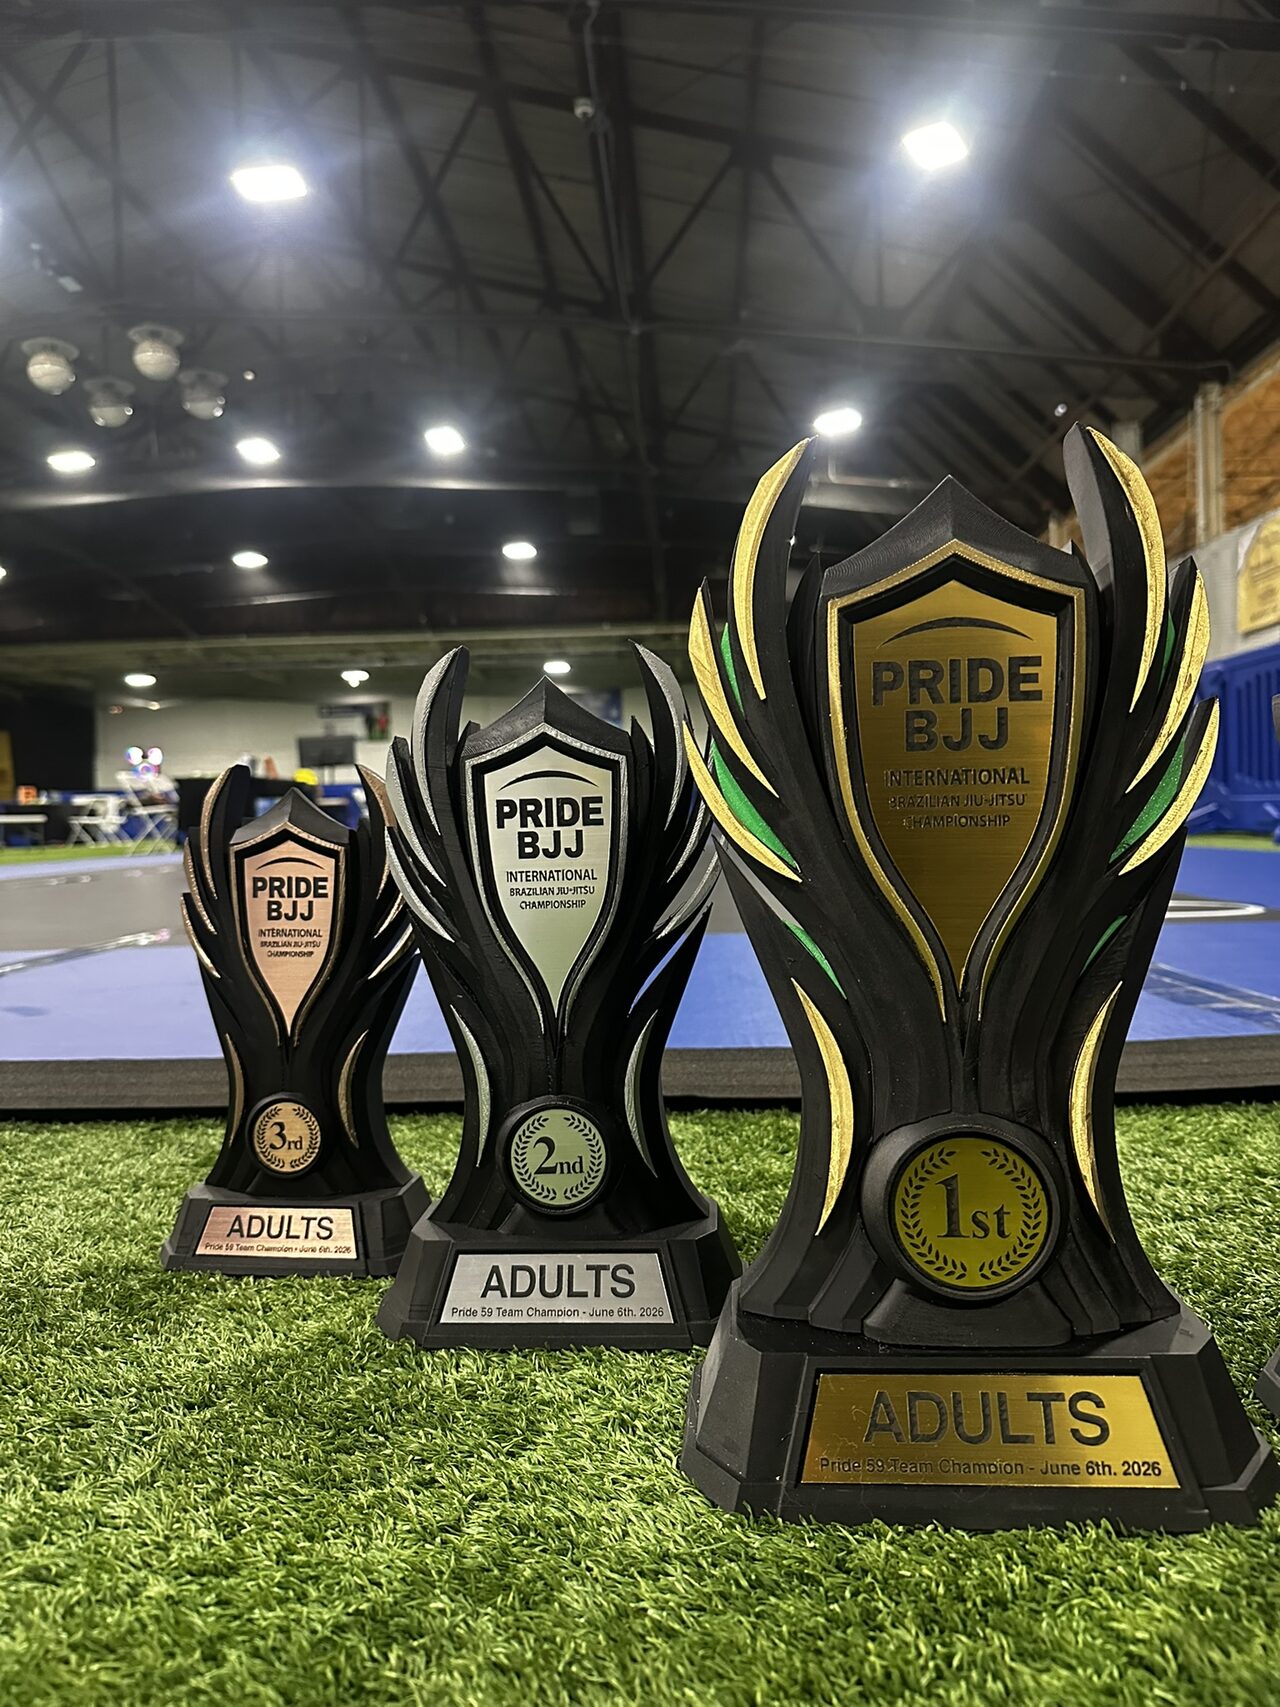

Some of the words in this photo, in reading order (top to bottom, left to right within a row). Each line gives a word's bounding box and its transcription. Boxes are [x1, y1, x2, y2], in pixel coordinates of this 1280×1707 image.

[872, 655, 1044, 706] PRIDE
[904, 707, 1009, 752] BJJ
[884, 767, 1030, 787] INTERNATIONAL
[889, 795, 960, 809] BRAZILIAN
[963, 793, 1026, 807] JIU-JITSU
[495, 795, 604, 829] PRIDE
[904, 814, 1011, 829] CHAMPIONSHIP
[517, 829, 584, 860] BJJ
[506, 868, 598, 883] INTERNATIONAL
[252, 876, 329, 898] PRIDE
[509, 886, 555, 897] BRAZILIAN
[556, 885, 595, 895] JIU-JITSU
[267, 900, 314, 921] BJJ
[519, 899, 587, 910] CHAMPIONSHIP
[258, 928, 323, 938] INTERNATIONAL
[266, 950, 315, 958] CHAMPIONSHIP
[269, 1121, 303, 1151] 3rd
[532, 1135, 585, 1175] 2nd
[935, 1173, 1012, 1239] 1st
[226, 1214, 334, 1240] ADULTS
[204, 1242, 223, 1251] Pride
[236, 1243, 254, 1252] Team
[256, 1244, 294, 1253] Champion
[334, 1245, 352, 1254] 2026
[480, 1263, 636, 1299] ADULTS
[451, 1306, 478, 1317] Pride
[480, 1306, 493, 1317] 59
[496, 1306, 523, 1317] Team
[526, 1306, 580, 1318] Champion
[588, 1306, 614, 1317] June
[617, 1306, 636, 1317] 6th.
[639, 1306, 664, 1317] 2026
[863, 1390, 1111, 1447] ADULTS
[819, 1457, 861, 1473] Pride
[866, 1458, 885, 1473] 59
[889, 1458, 934, 1473] Team
[938, 1458, 1024, 1476] Champion
[1040, 1460, 1081, 1476] June
[1085, 1460, 1117, 1476] 6th.
[1121, 1460, 1162, 1477] 2026
